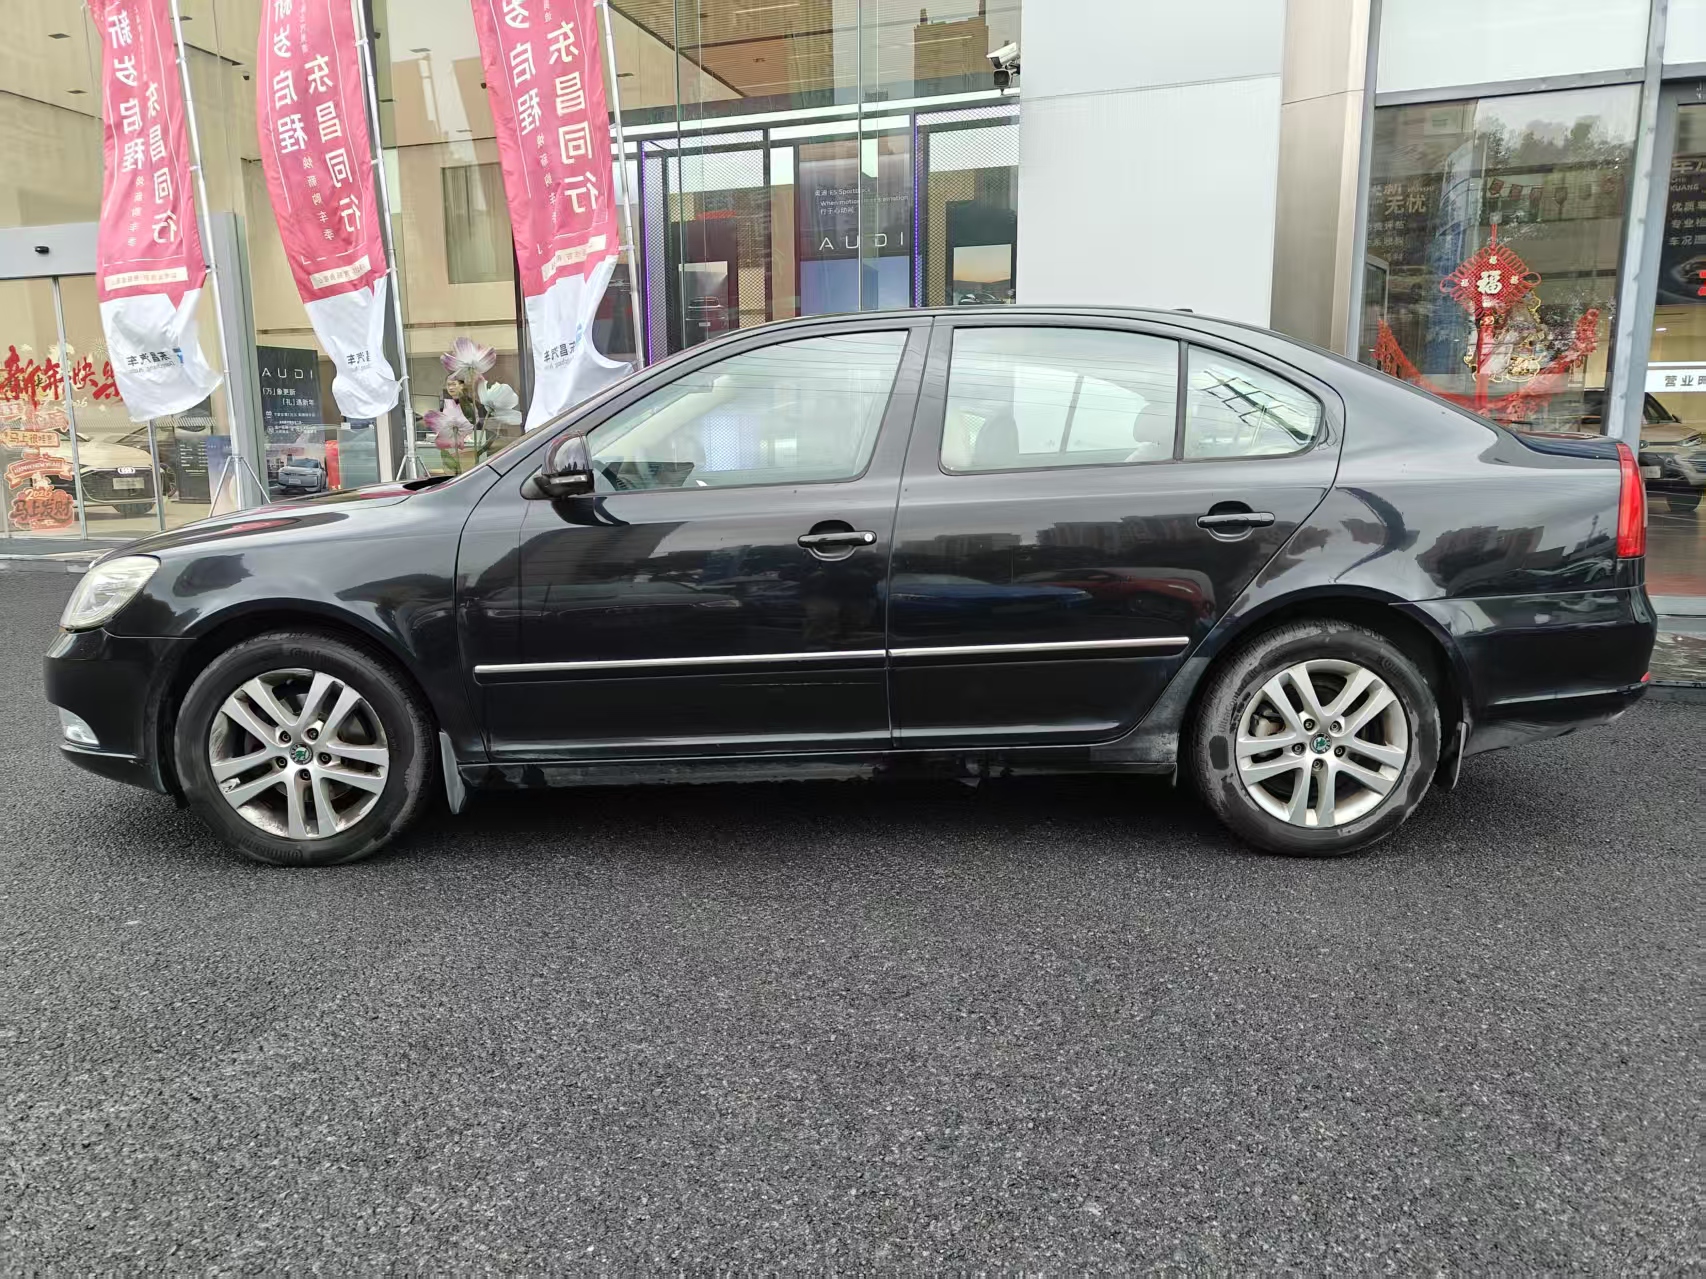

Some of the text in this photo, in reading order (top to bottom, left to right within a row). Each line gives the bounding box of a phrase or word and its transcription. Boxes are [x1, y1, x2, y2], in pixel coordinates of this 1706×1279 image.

[1384, 194, 1426, 215] 无忧
[818, 231, 904, 251] AUDI
[1476, 270, 1503, 295] 福
[261, 367, 313, 380] AUDI
[25, 488, 53, 500] 2026
[9, 498, 72, 522] 马上发财
